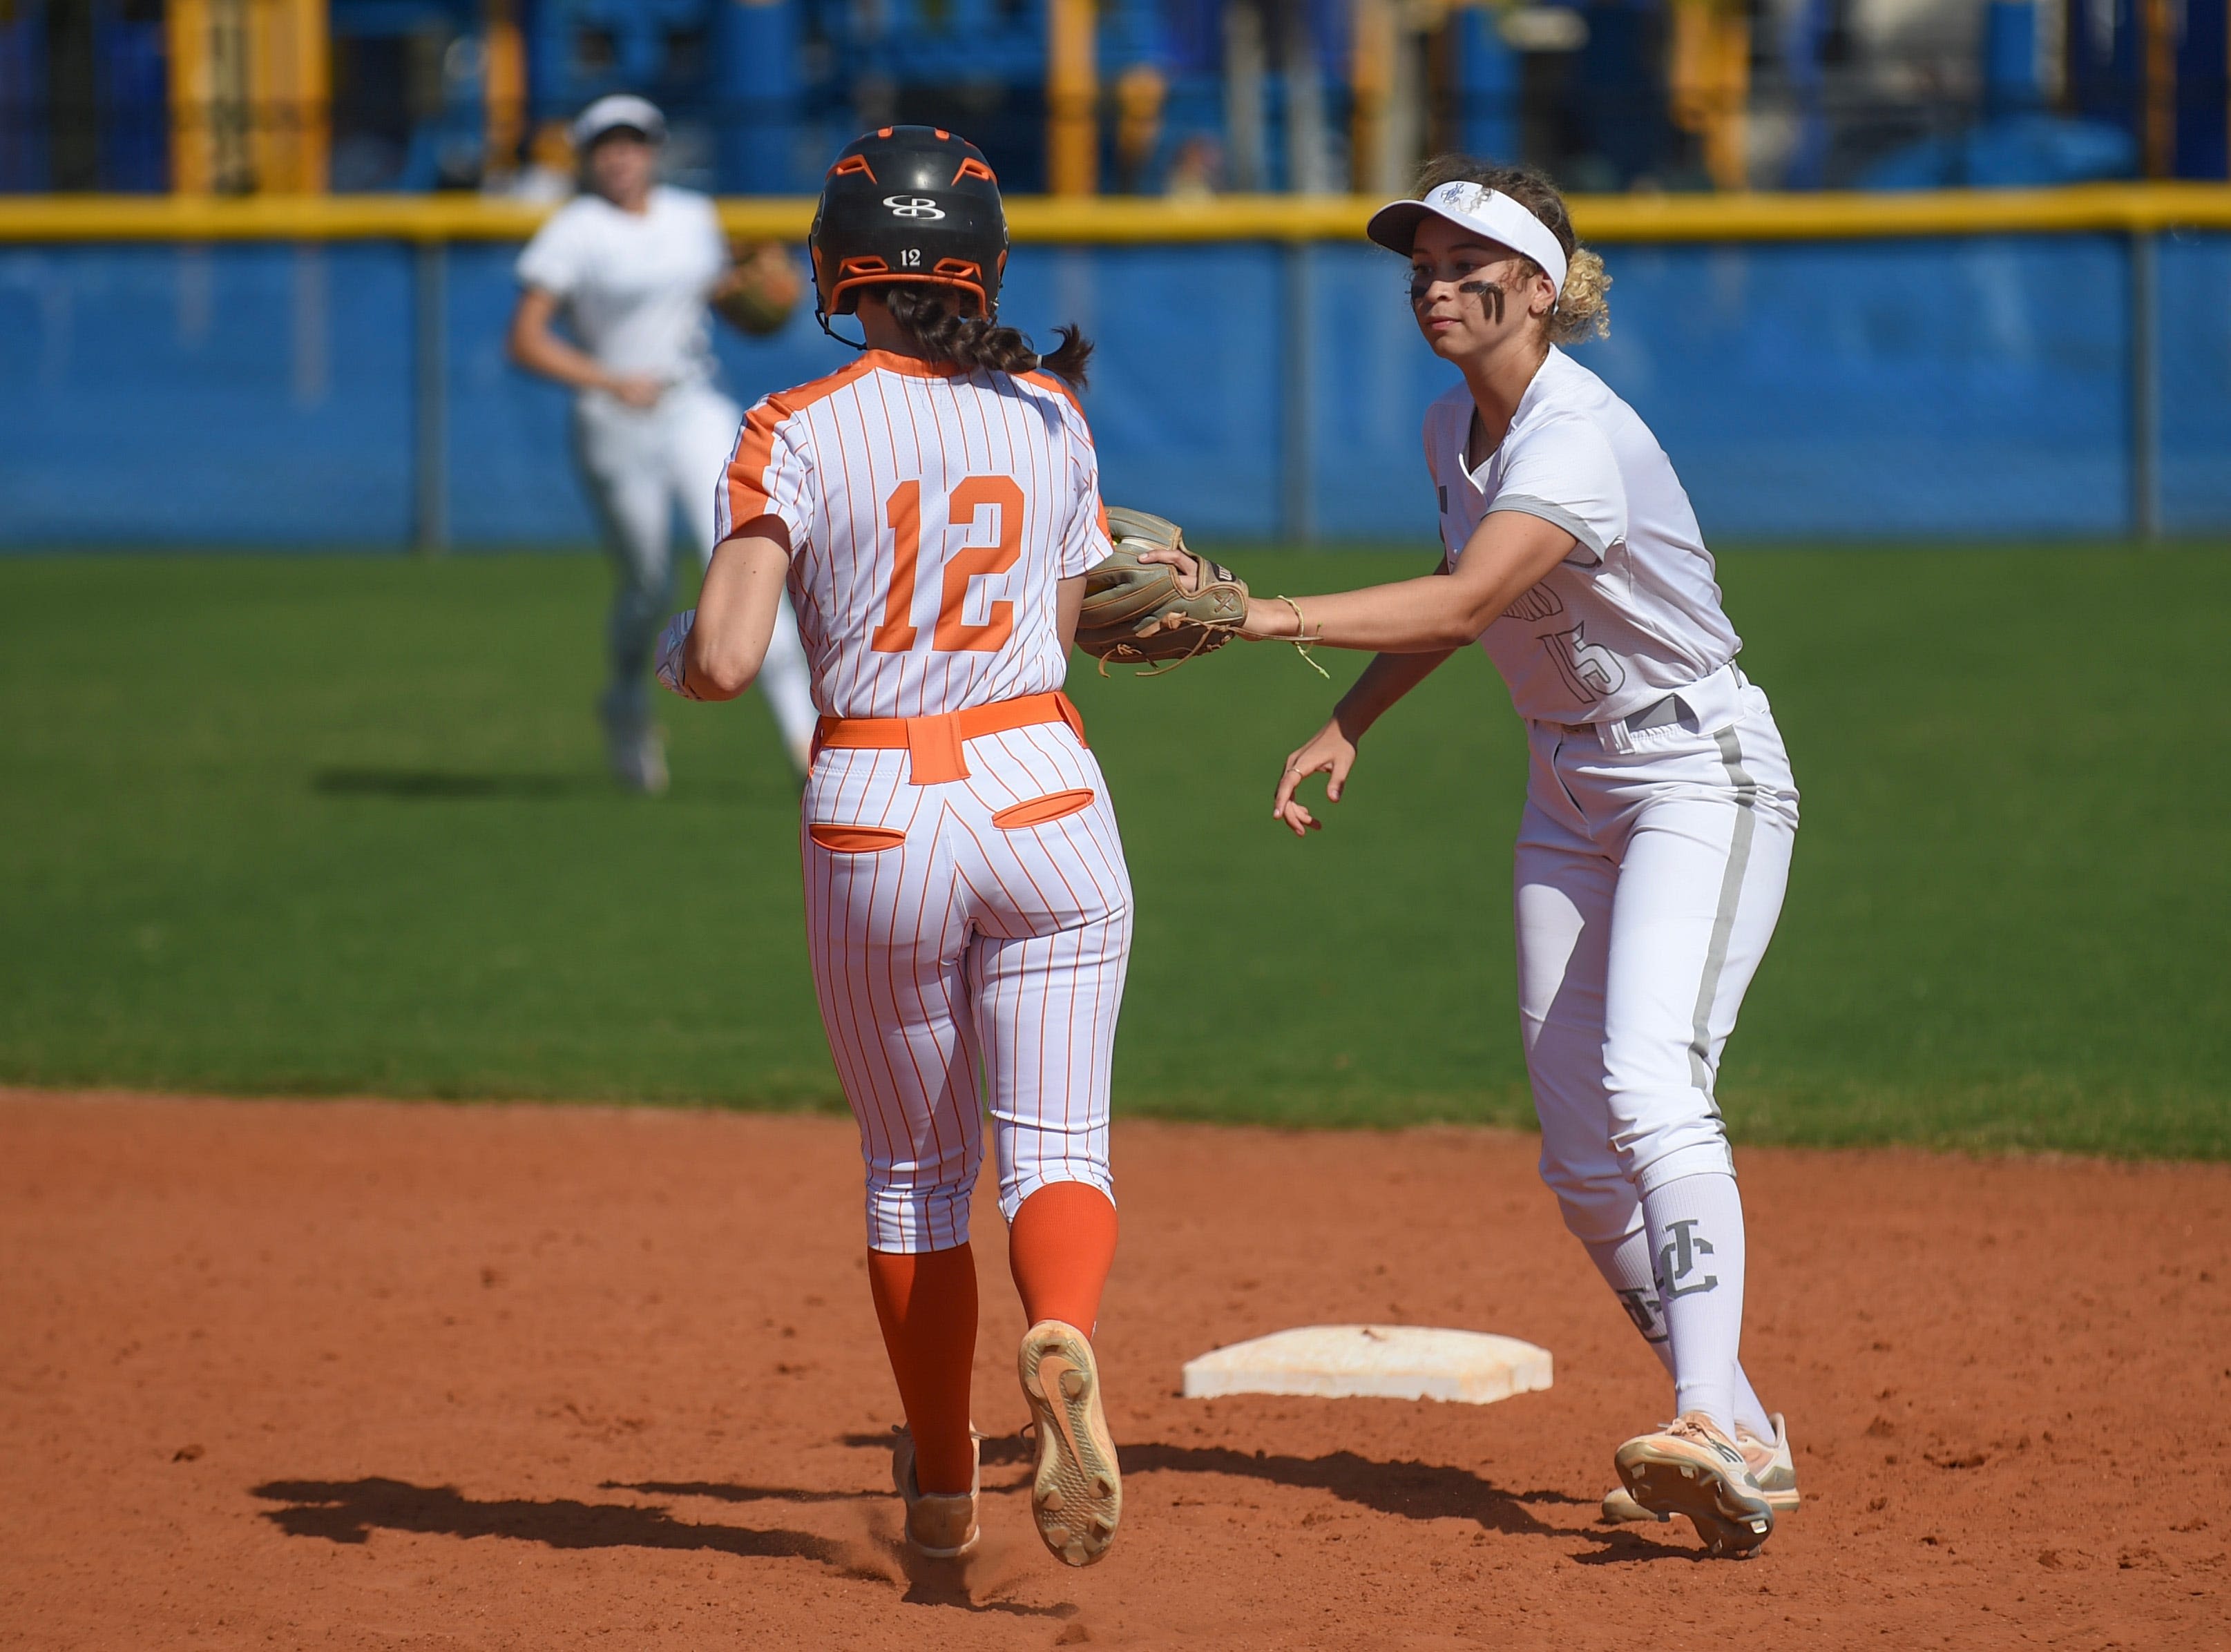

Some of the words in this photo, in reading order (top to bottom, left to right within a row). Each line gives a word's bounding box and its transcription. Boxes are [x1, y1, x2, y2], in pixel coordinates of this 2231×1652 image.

[900, 249, 921, 267] 12
[870, 475, 1024, 653] 12
[1535, 620, 1625, 704] 15
